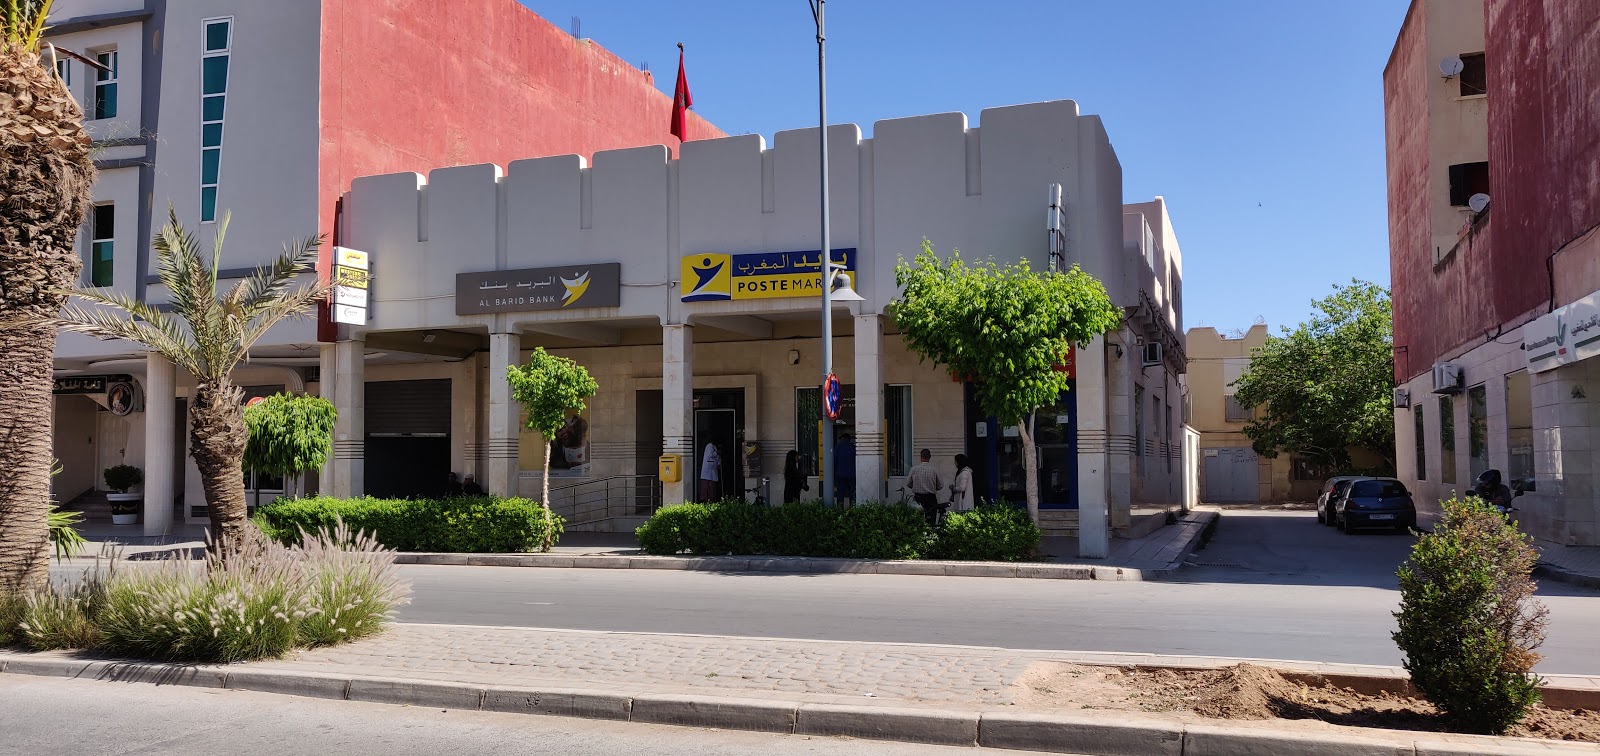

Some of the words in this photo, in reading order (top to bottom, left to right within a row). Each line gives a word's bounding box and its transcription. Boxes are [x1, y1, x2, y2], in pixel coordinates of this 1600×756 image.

[738, 254, 789, 275] المغرب
[793, 252, 847, 270] بيد
[479, 280, 508, 290] بنك
[516, 276, 556, 289] البريد
[738, 280, 788, 292] POSTE
[792, 278, 834, 290] MAR
[479, 299, 490, 307] AL
[495, 297, 524, 306] BARID
[529, 295, 556, 304] BANK
